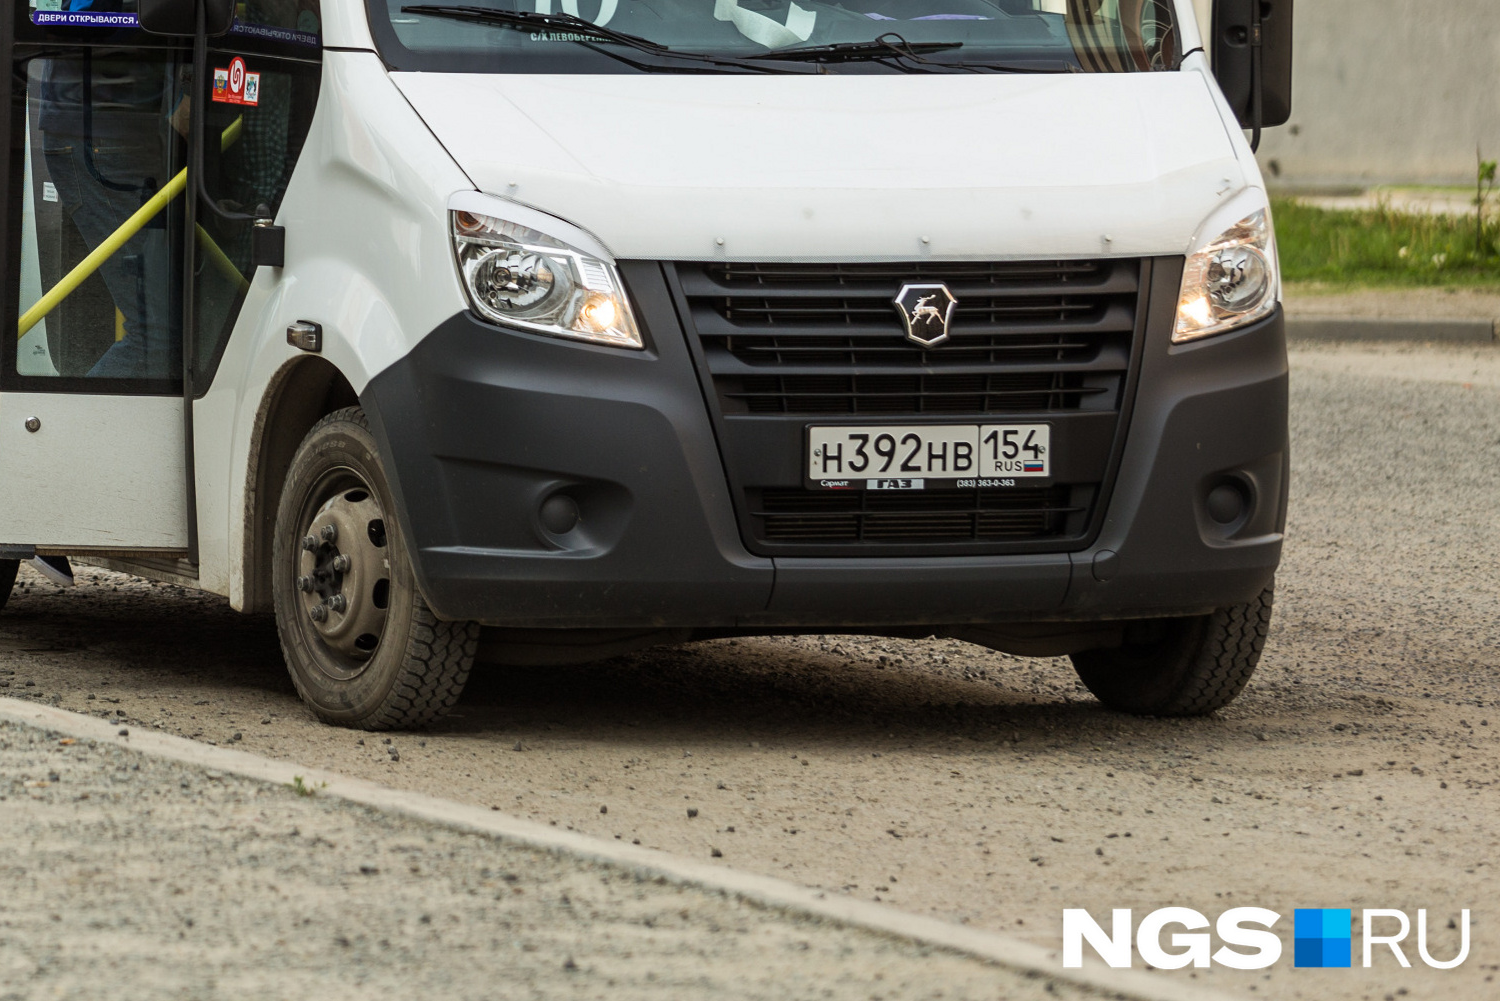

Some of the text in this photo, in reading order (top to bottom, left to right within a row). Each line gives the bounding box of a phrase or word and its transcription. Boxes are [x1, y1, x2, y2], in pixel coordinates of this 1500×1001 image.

[38, 14, 135, 24] ДВЕРИ ОТКРЫВАЮТСЯ
[822, 429, 1040, 473] Н392НВ 154
[995, 461, 1022, 472] RUS
[820, 479, 1015, 489] Сармат ГАЗ (383) 363-0-363
